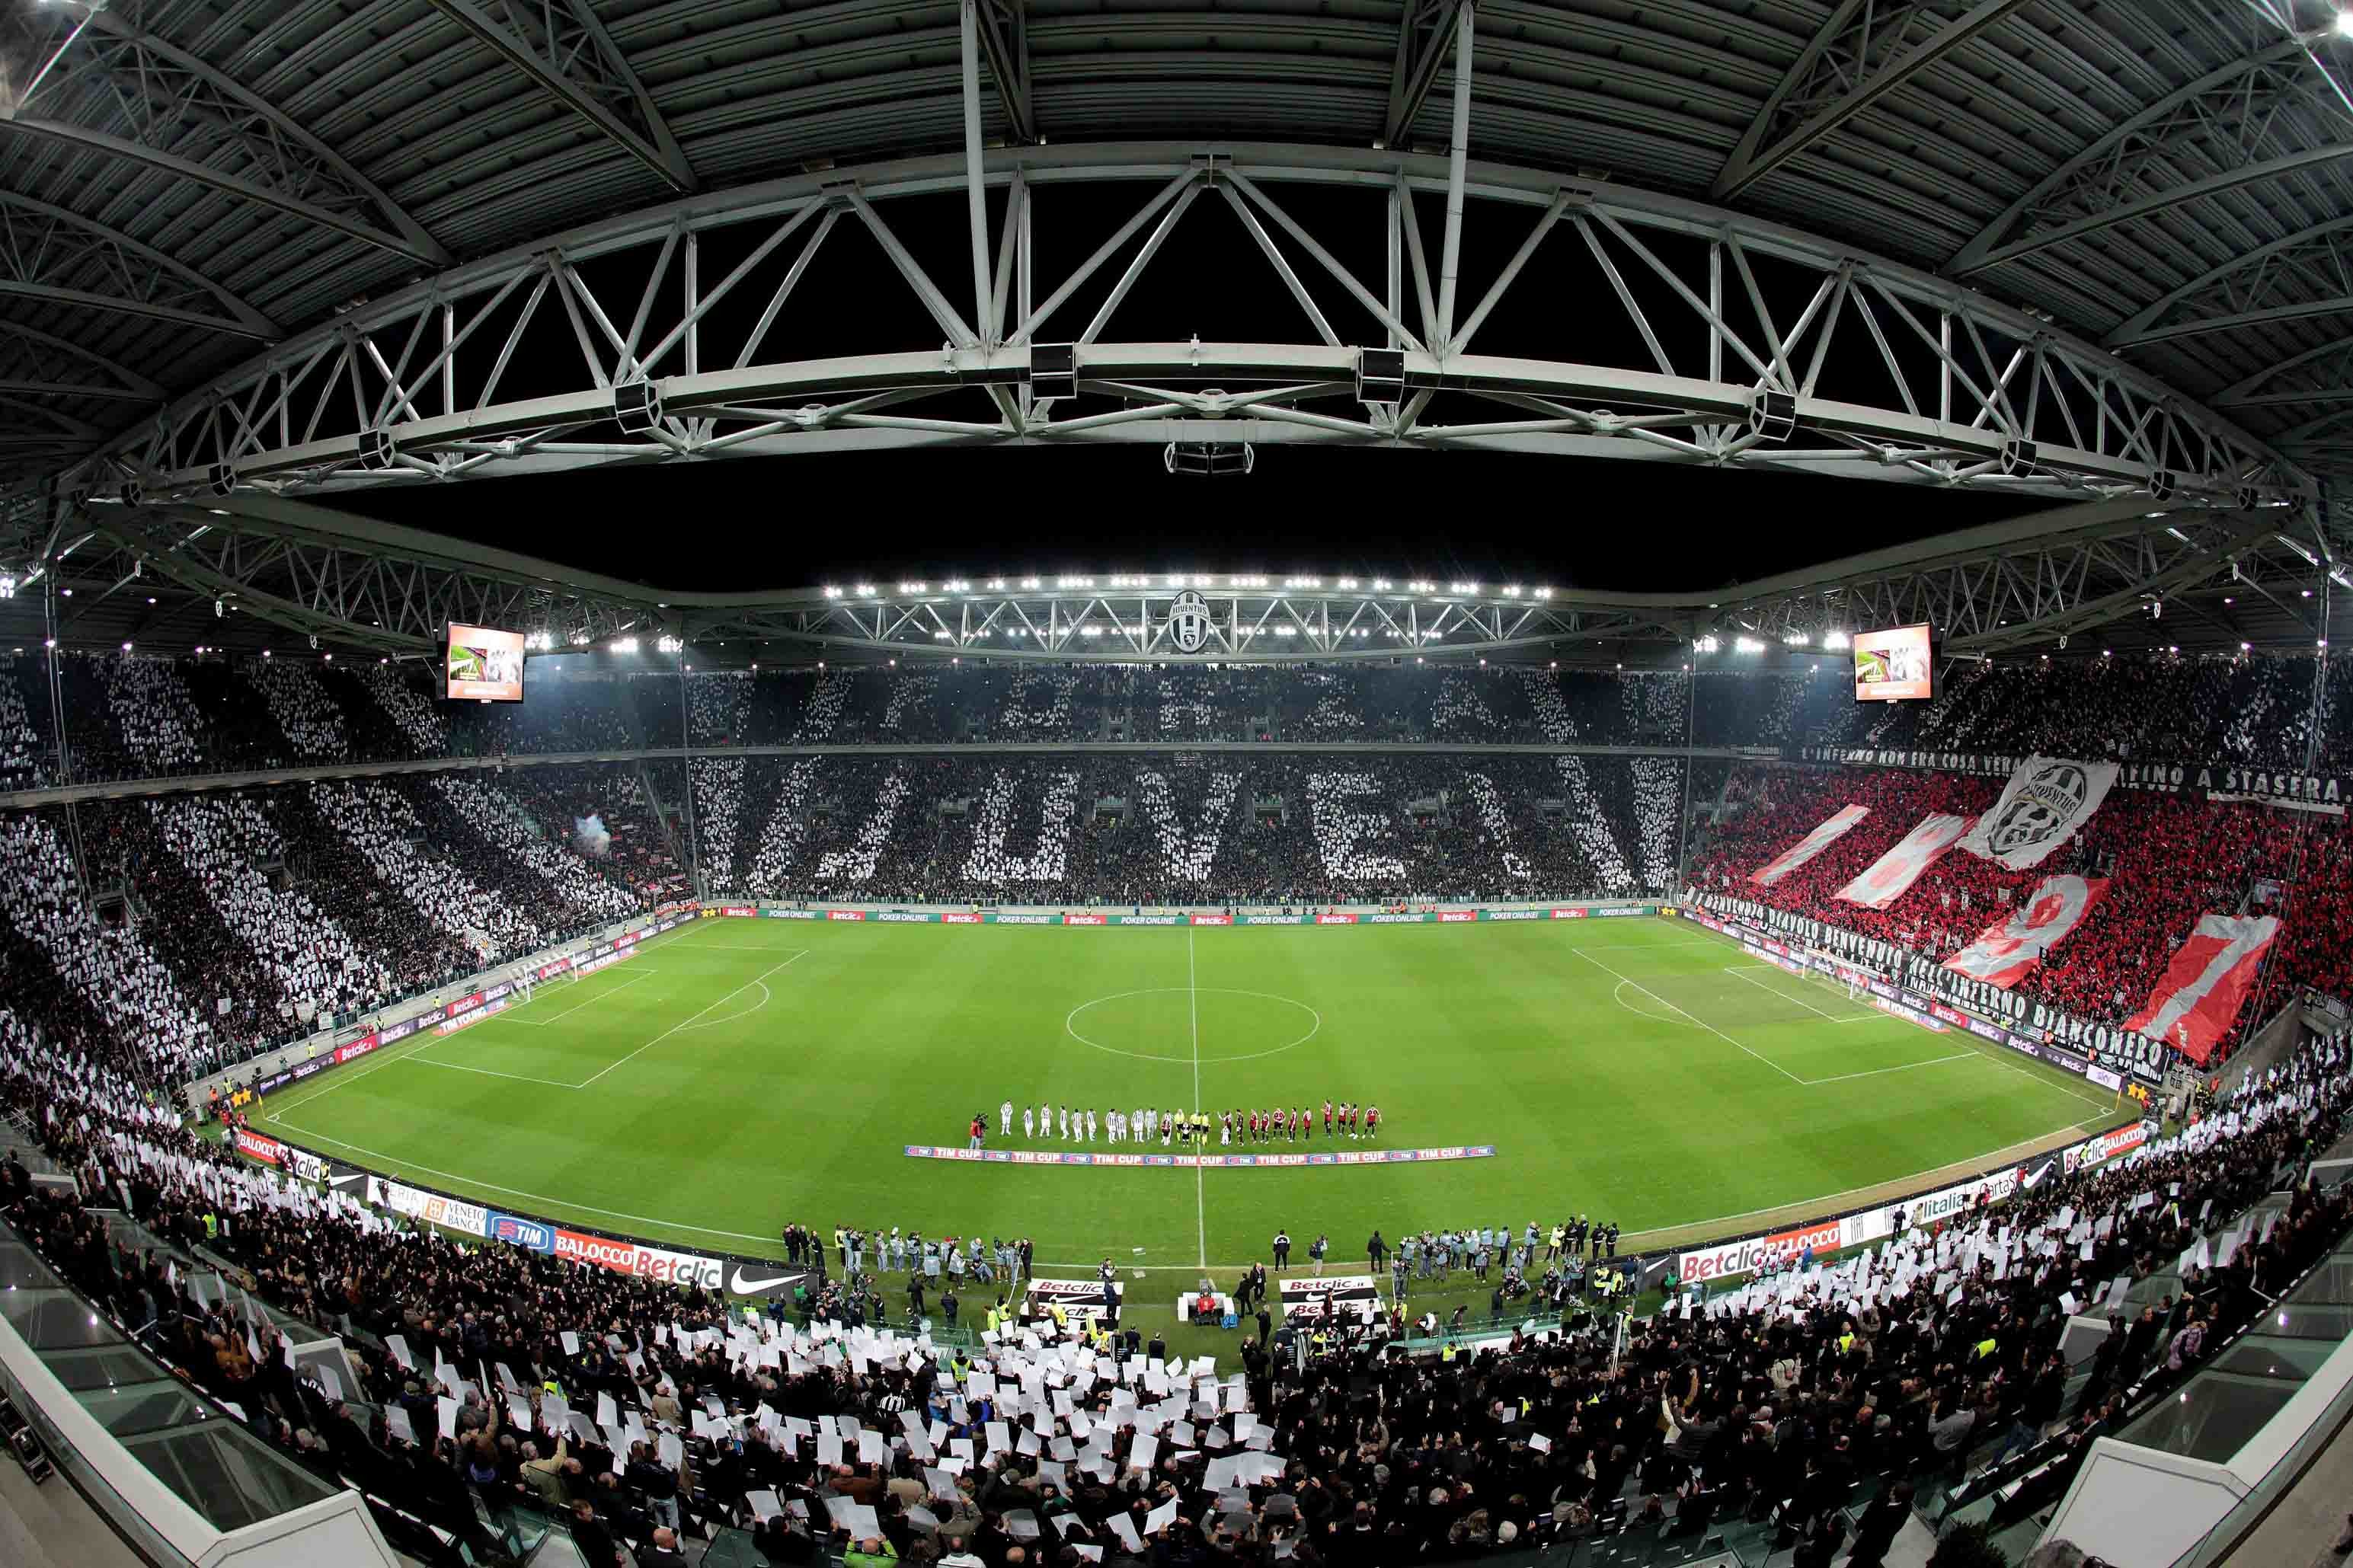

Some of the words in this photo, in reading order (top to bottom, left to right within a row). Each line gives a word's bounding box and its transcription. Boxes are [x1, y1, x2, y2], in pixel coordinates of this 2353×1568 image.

[1173, 605, 1207, 615] JUVENTUS
[1879, 749, 1905, 766] NON
[1942, 753, 1975, 768] COSA
[439, 1019, 459, 1033] TIM
[2032, 1004, 2163, 1068] BIANCONERO
[938, 1148, 955, 1158] TIM
[958, 1149, 981, 1159] CUP
[1015, 1153, 1034, 1162] TIM
[1036, 1154, 1060, 1162] CUP
[1095, 1154, 1114, 1164] TIM
[1118, 1155, 1141, 1164] CUP
[1178, 1156, 1196, 1164] TIM
[1200, 1156, 1223, 1164] CUP
[1260, 1156, 1279, 1164] TIM
[1363, 1152, 1385, 1161] CUP
[1420, 1150, 1437, 1158] TIM
[1441, 1148, 1463, 1157] CUP
[2065, 1144, 2105, 1171] Beclic
[449, 1203, 486, 1222] VENETO
[1913, 1193, 1965, 1220] litalia
[448, 1215, 481, 1233] BANCA
[517, 1225, 542, 1244] TIM
[1850, 1215, 1865, 1243] FIAT
[555, 1235, 635, 1266] BALOCCO
[1682, 1241, 1764, 1281] Betclic
[635, 1250, 721, 1287] Betclic
